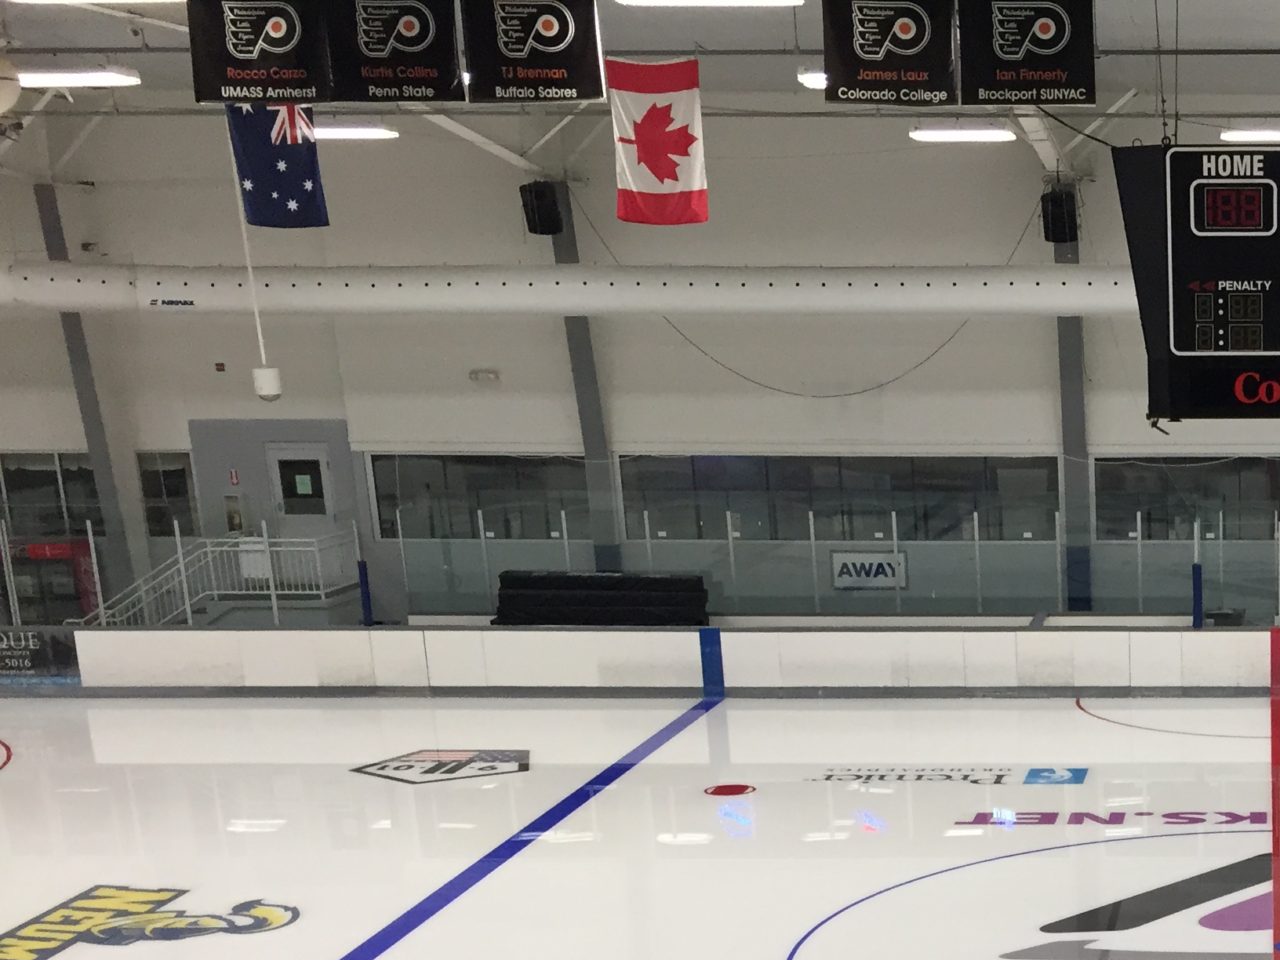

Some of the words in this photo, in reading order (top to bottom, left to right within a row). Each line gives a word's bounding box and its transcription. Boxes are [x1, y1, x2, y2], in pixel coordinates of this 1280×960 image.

[227, 67, 267, 79] Rocco
[502, 67, 513, 78] TJ
[517, 67, 568, 78] Brennan
[857, 69, 898, 80] James
[901, 69, 929, 80] Laux
[996, 69, 1016, 80] Ian
[1020, 68, 1068, 82] Finnerty
[221, 86, 263, 97] UMASS
[266, 86, 316, 97] Amherst
[369, 86, 399, 97] Penn
[403, 85, 435, 97] State
[495, 86, 535, 98] Buffalo
[538, 86, 577, 98] Sabres
[838, 87, 896, 100] Colorado
[900, 89, 948, 102] College
[978, 88, 1037, 101] Brockport
[1040, 88, 1086, 100] SUNYAC
[1202, 155, 1264, 177] HOME
[1218, 281, 1272, 291] PENALTY
[838, 562, 901, 577] AWAY
[811, 774, 1007, 785] Premier
